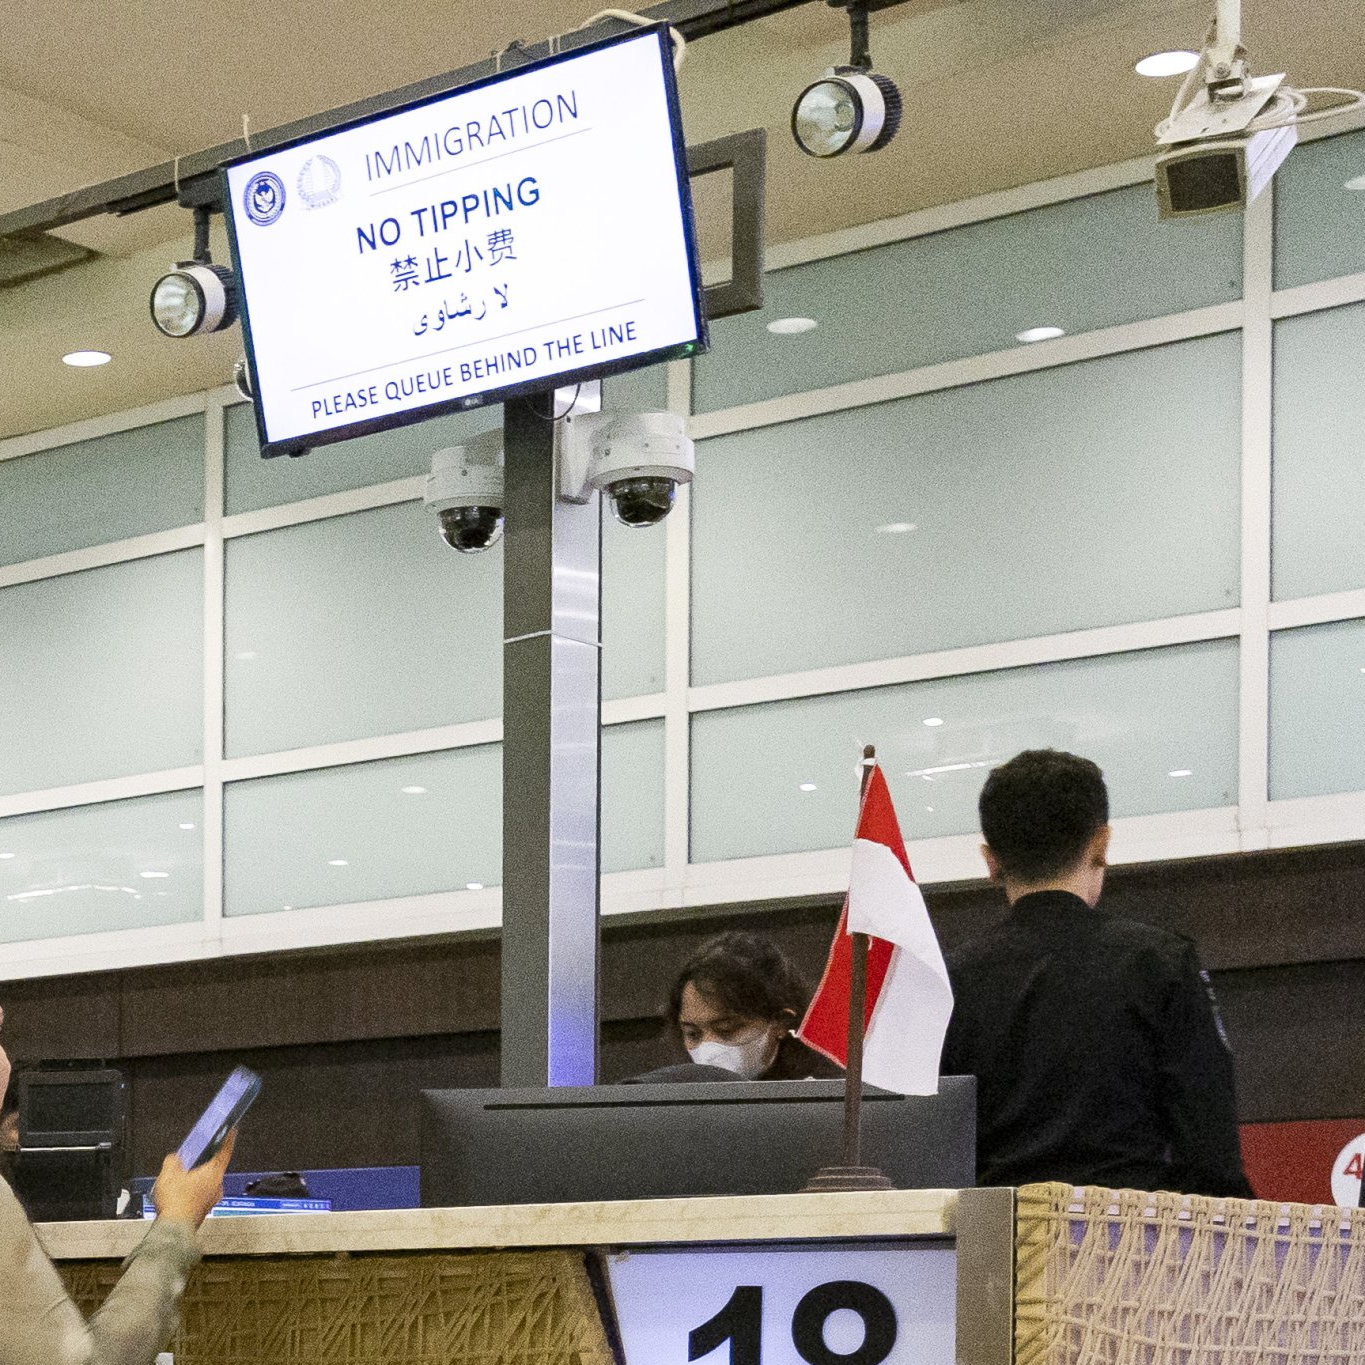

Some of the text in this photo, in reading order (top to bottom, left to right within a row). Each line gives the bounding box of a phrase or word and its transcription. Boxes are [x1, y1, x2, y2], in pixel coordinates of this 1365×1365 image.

[365, 89, 579, 181] IMMIGRATION
[356, 176, 541, 255] NO TIPPING
[389, 228, 518, 292] 禁止小费
[311, 386, 379, 419] PLEASE
[384, 367, 454, 402] QUEUE
[460, 346, 538, 382] BEHIND
[543, 333, 585, 361] THE
[590, 320, 638, 350] LINE
